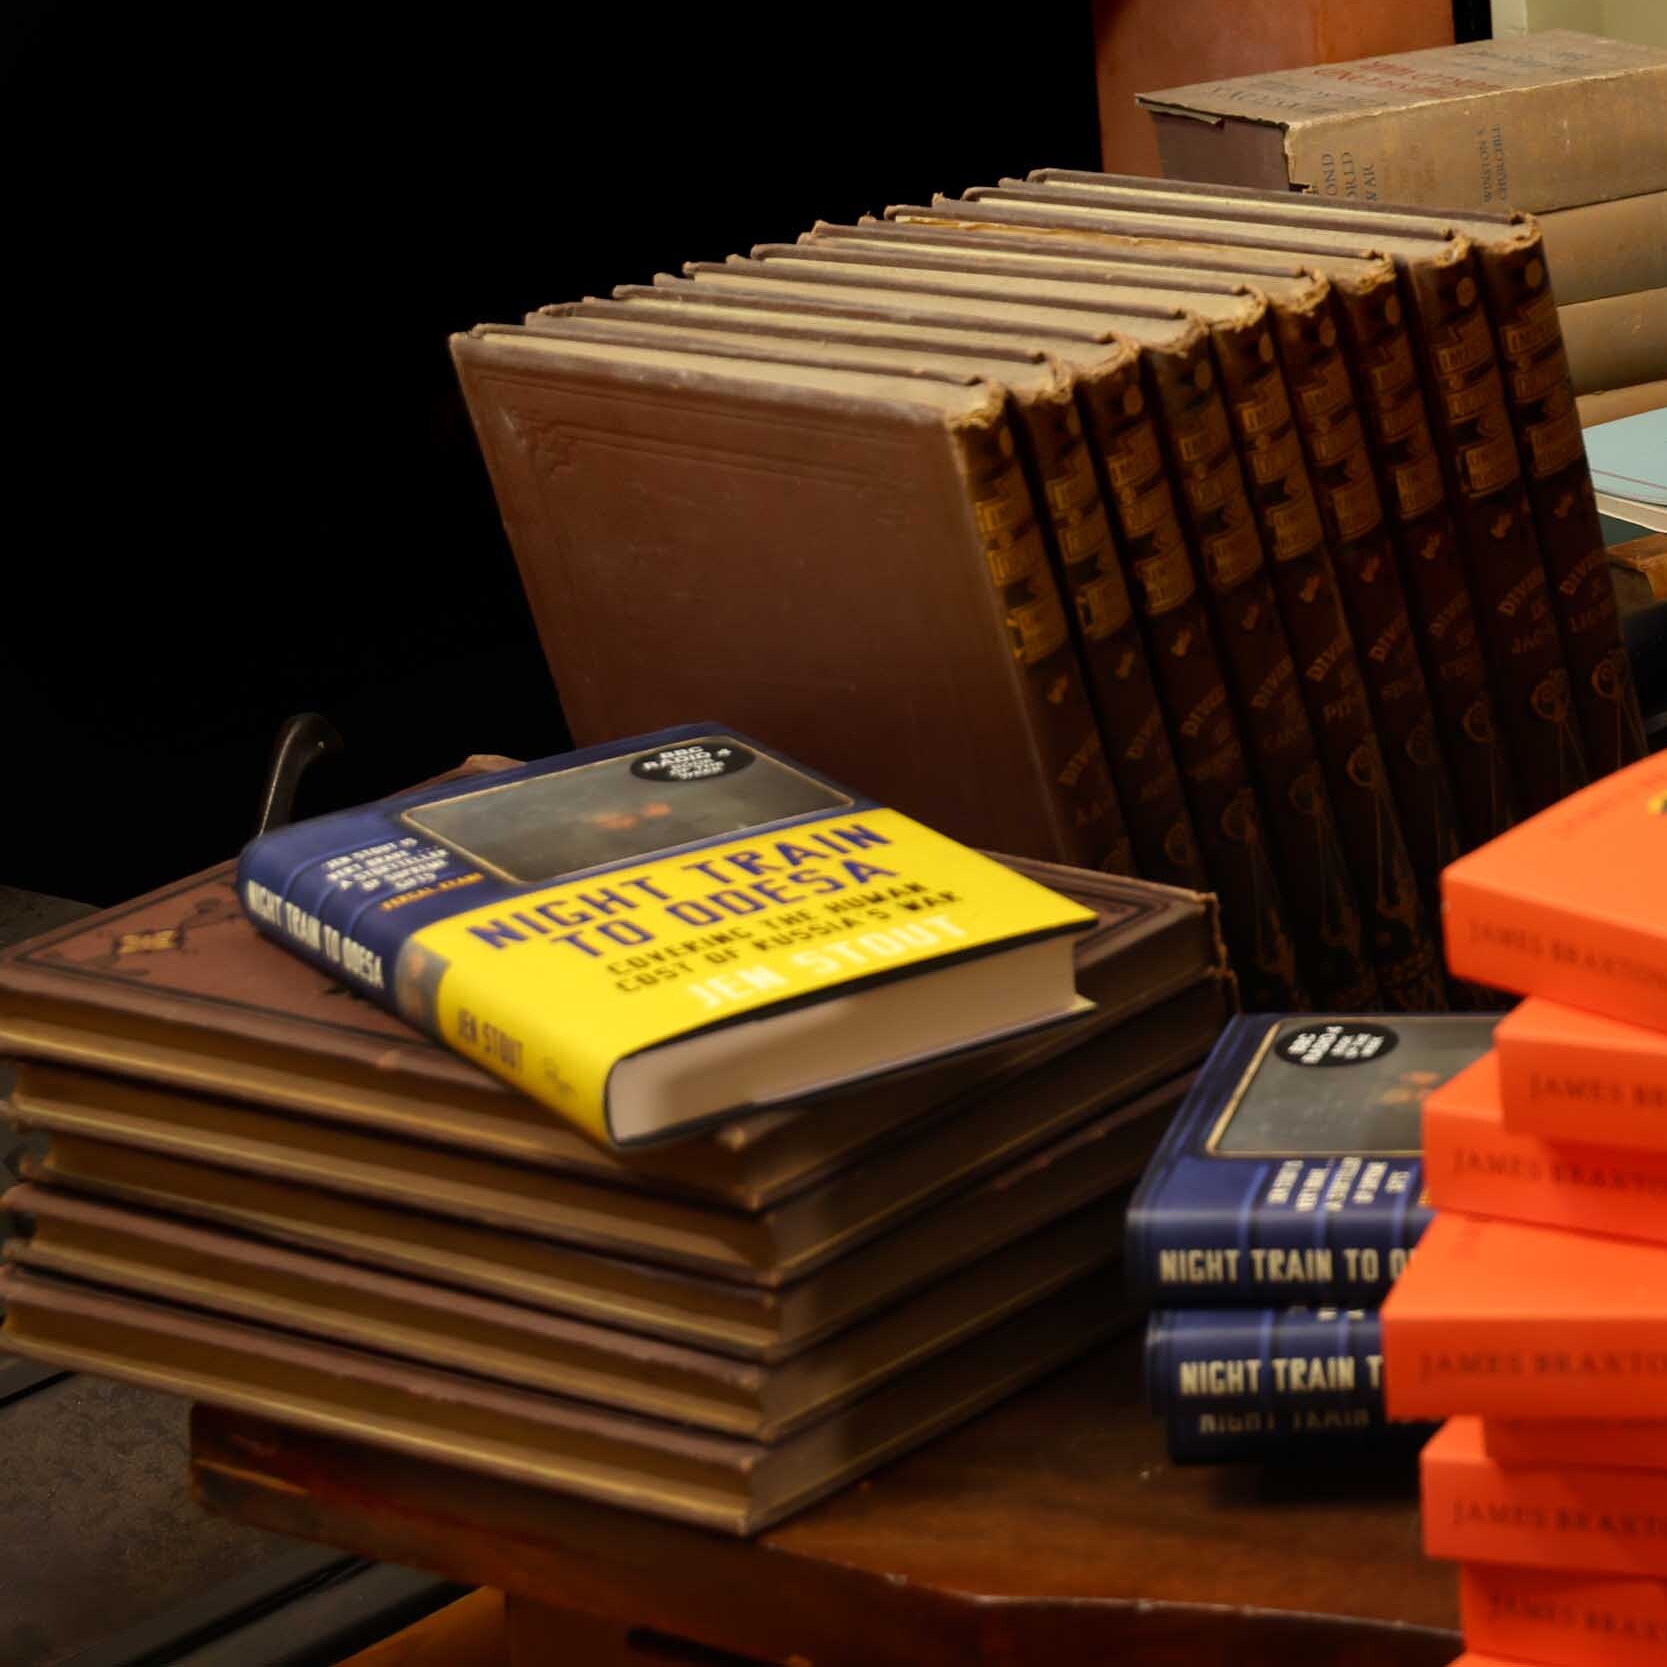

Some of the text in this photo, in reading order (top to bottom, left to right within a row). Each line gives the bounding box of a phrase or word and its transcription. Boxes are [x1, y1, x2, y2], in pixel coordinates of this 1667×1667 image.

[1479, 139, 1495, 205] WINSTON
[1495, 123, 1509, 203] CHURCHILL
[640, 753, 711, 772] RADIO
[466, 823, 895, 950] NIGHT TRAIN
[549, 857, 899, 959] TO ODESA
[247, 879, 385, 990] NIGHT TRAIN TO ODESA
[606, 880, 931, 977] COVERING THE HUMAN
[614, 890, 964, 995] COST OF RUSSIA'S WAR
[685, 914, 969, 1010] JEN STOUT
[457, 1007, 524, 1073] JEN STOUT
[1529, 1071, 1624, 1106] JAMES
[1452, 1149, 1546, 1188] JAMES
[1158, 1247, 1381, 1284] NIGHT TRAIN TO
[1179, 1355, 1357, 1397] NIGHT TRAIN
[1418, 1351, 1525, 1380] JAMES
[1451, 1497, 1548, 1533] JAMES
